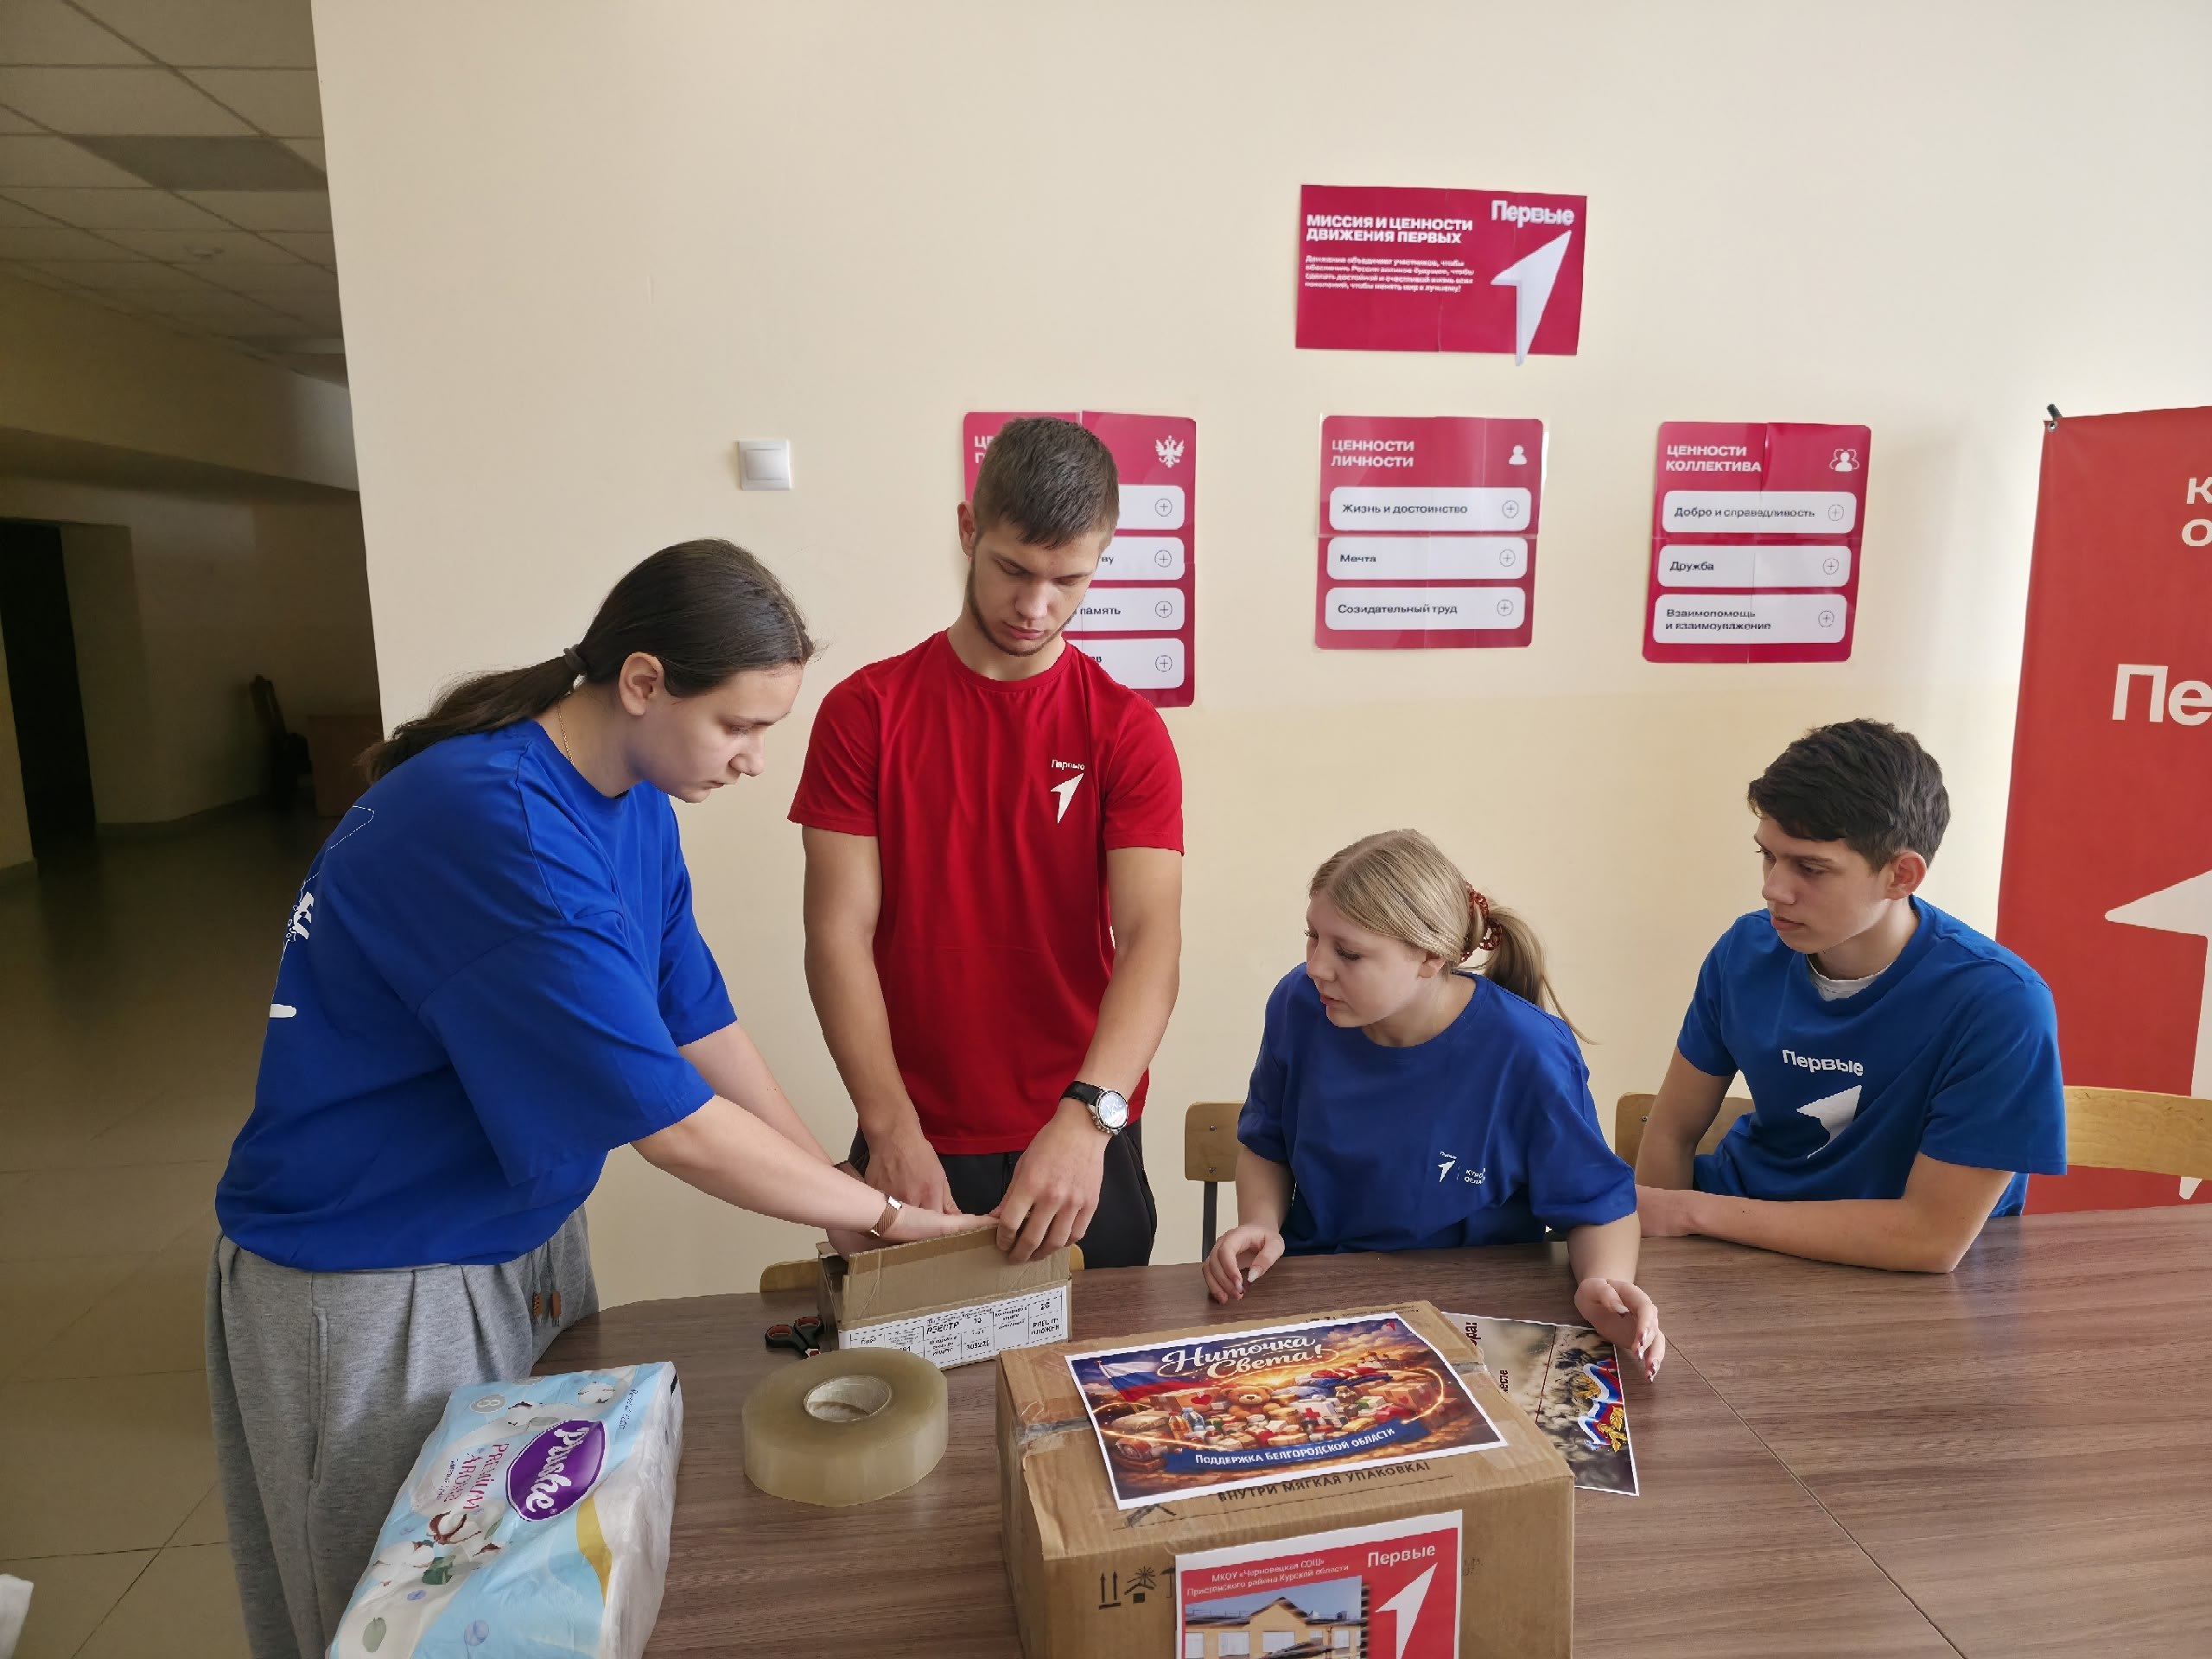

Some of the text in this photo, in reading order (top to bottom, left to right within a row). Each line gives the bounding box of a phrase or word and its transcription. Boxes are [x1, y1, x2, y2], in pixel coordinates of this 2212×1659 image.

[1306, 214, 1473, 231] МИССИЯ И ЦЕННОСТИ
[1491, 200, 1575, 228] Первые
[1306, 228, 1462, 244] ДВИЖЕНИЯ ПЕРВЫХ
[1332, 440, 1414, 453] ЦЕННОСТИ
[1667, 444, 1747, 456] ЦЕННОСТИ
[1331, 455, 1414, 467] ЛИЧНОСТИ
[1666, 461, 1762, 473] КОЛЛЕКТИВА
[2186, 476, 2212, 505] К
[1342, 504, 1381, 514] Жизнь
[1392, 505, 1468, 515] достоинство
[1674, 507, 1713, 518] Добро
[1724, 508, 1815, 518] справедливость
[2181, 518, 2212, 547] О
[1340, 554, 1376, 563] Мечта
[1669, 562, 1714, 572] Дружба
[1338, 604, 1458, 615] Созидательный труд
[1667, 608, 1756, 619] Взаимопомощь
[1675, 622, 1771, 632] взаимоуважение
[2112, 664, 2212, 726] Пе
[1782, 1049, 1864, 1077] Первые
[1159, 1336, 1316, 1374] Ниточка
[1207, 1344, 1323, 1379] Света!
[1195, 1428, 1395, 1465] ПОДДЕРЖКА БЕЛГОРОДСКОЙ ОБЛАСТИ
[1217, 1484, 1277, 1502] ВНУТРИ
[1282, 1475, 1342, 1492] МЯГКАЯ
[1367, 1544, 1436, 1568] Первые
[1211, 1571, 1237, 1582] МКОУ
[1300, 1558, 1325, 1568] СОШ»
[1248, 1576, 1279, 1588] района
[1280, 1570, 1314, 1584] Курской
[1315, 1565, 1349, 1576] области
